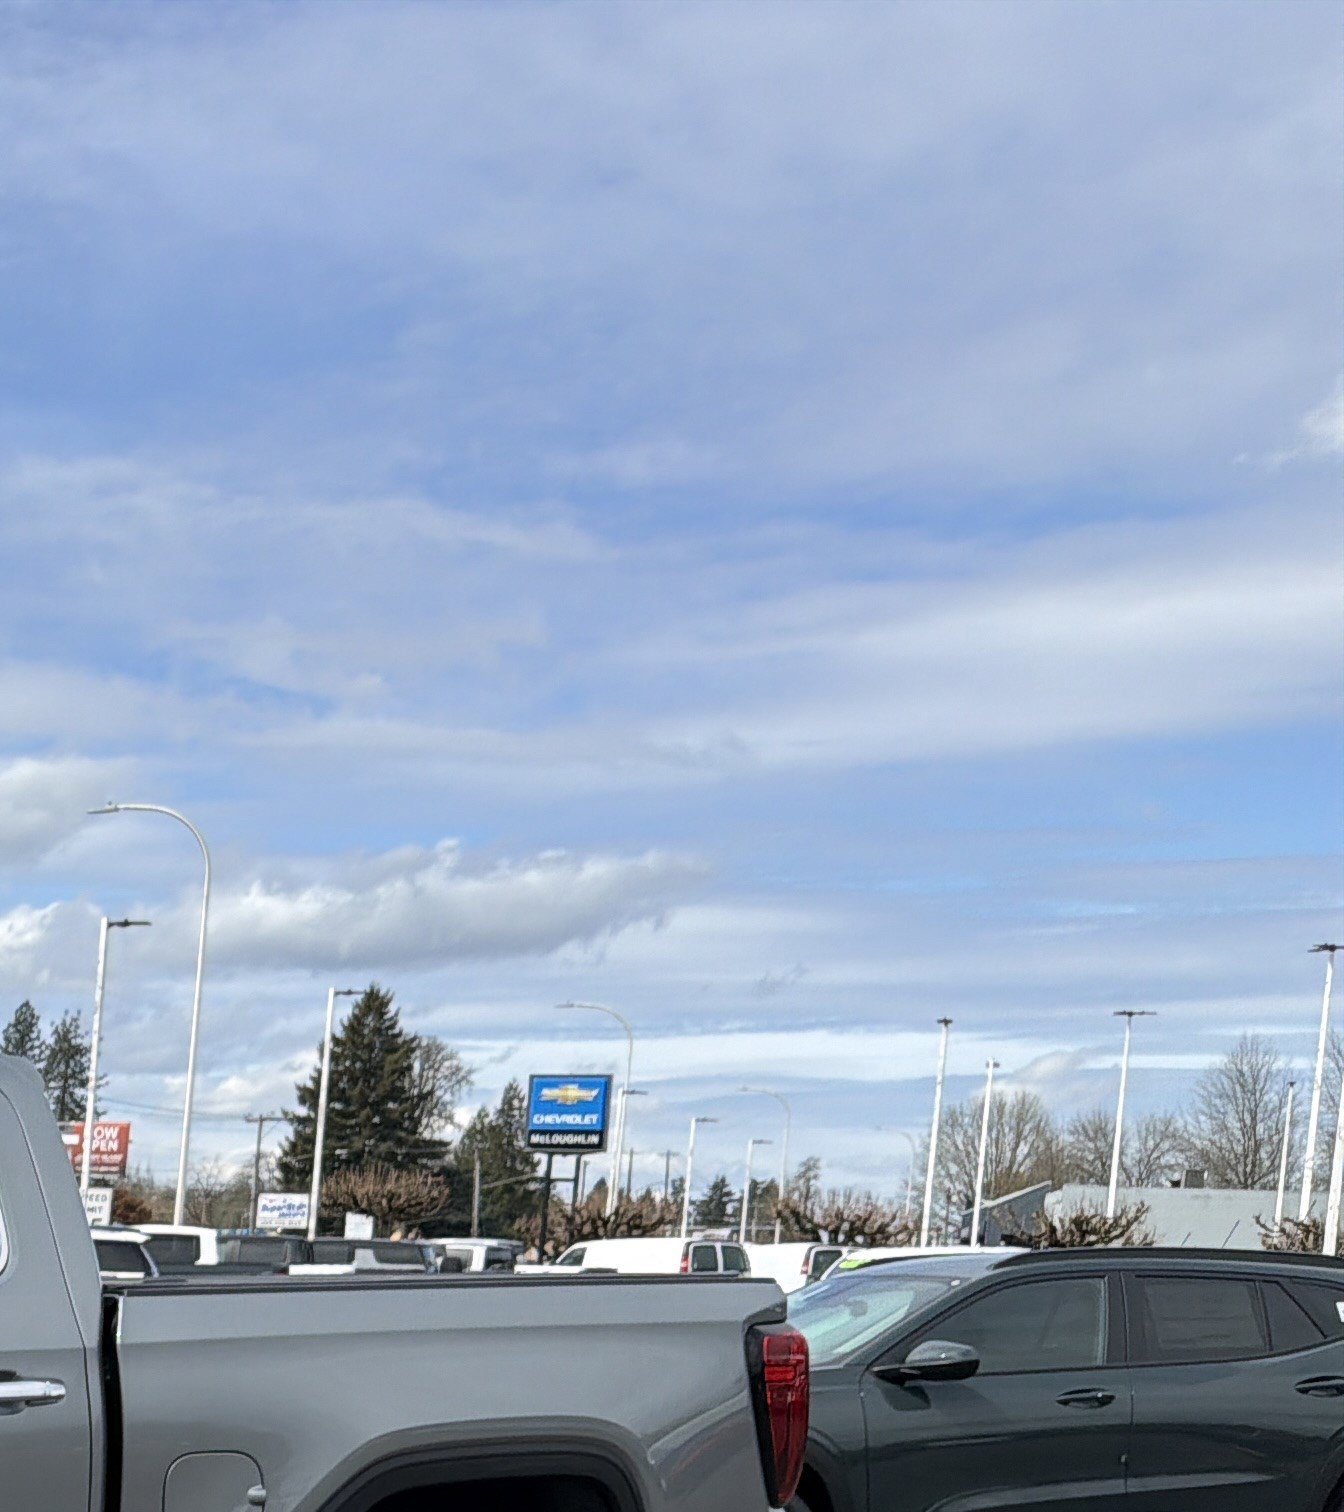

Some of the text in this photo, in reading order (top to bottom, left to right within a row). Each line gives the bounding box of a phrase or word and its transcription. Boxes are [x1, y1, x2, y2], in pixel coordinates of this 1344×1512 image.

[533, 1113, 599, 1125] CHEVROLET
[93, 1126, 120, 1139] OW
[530, 1133, 600, 1145] McLOUGHLIN
[92, 1139, 118, 1152] PEN
